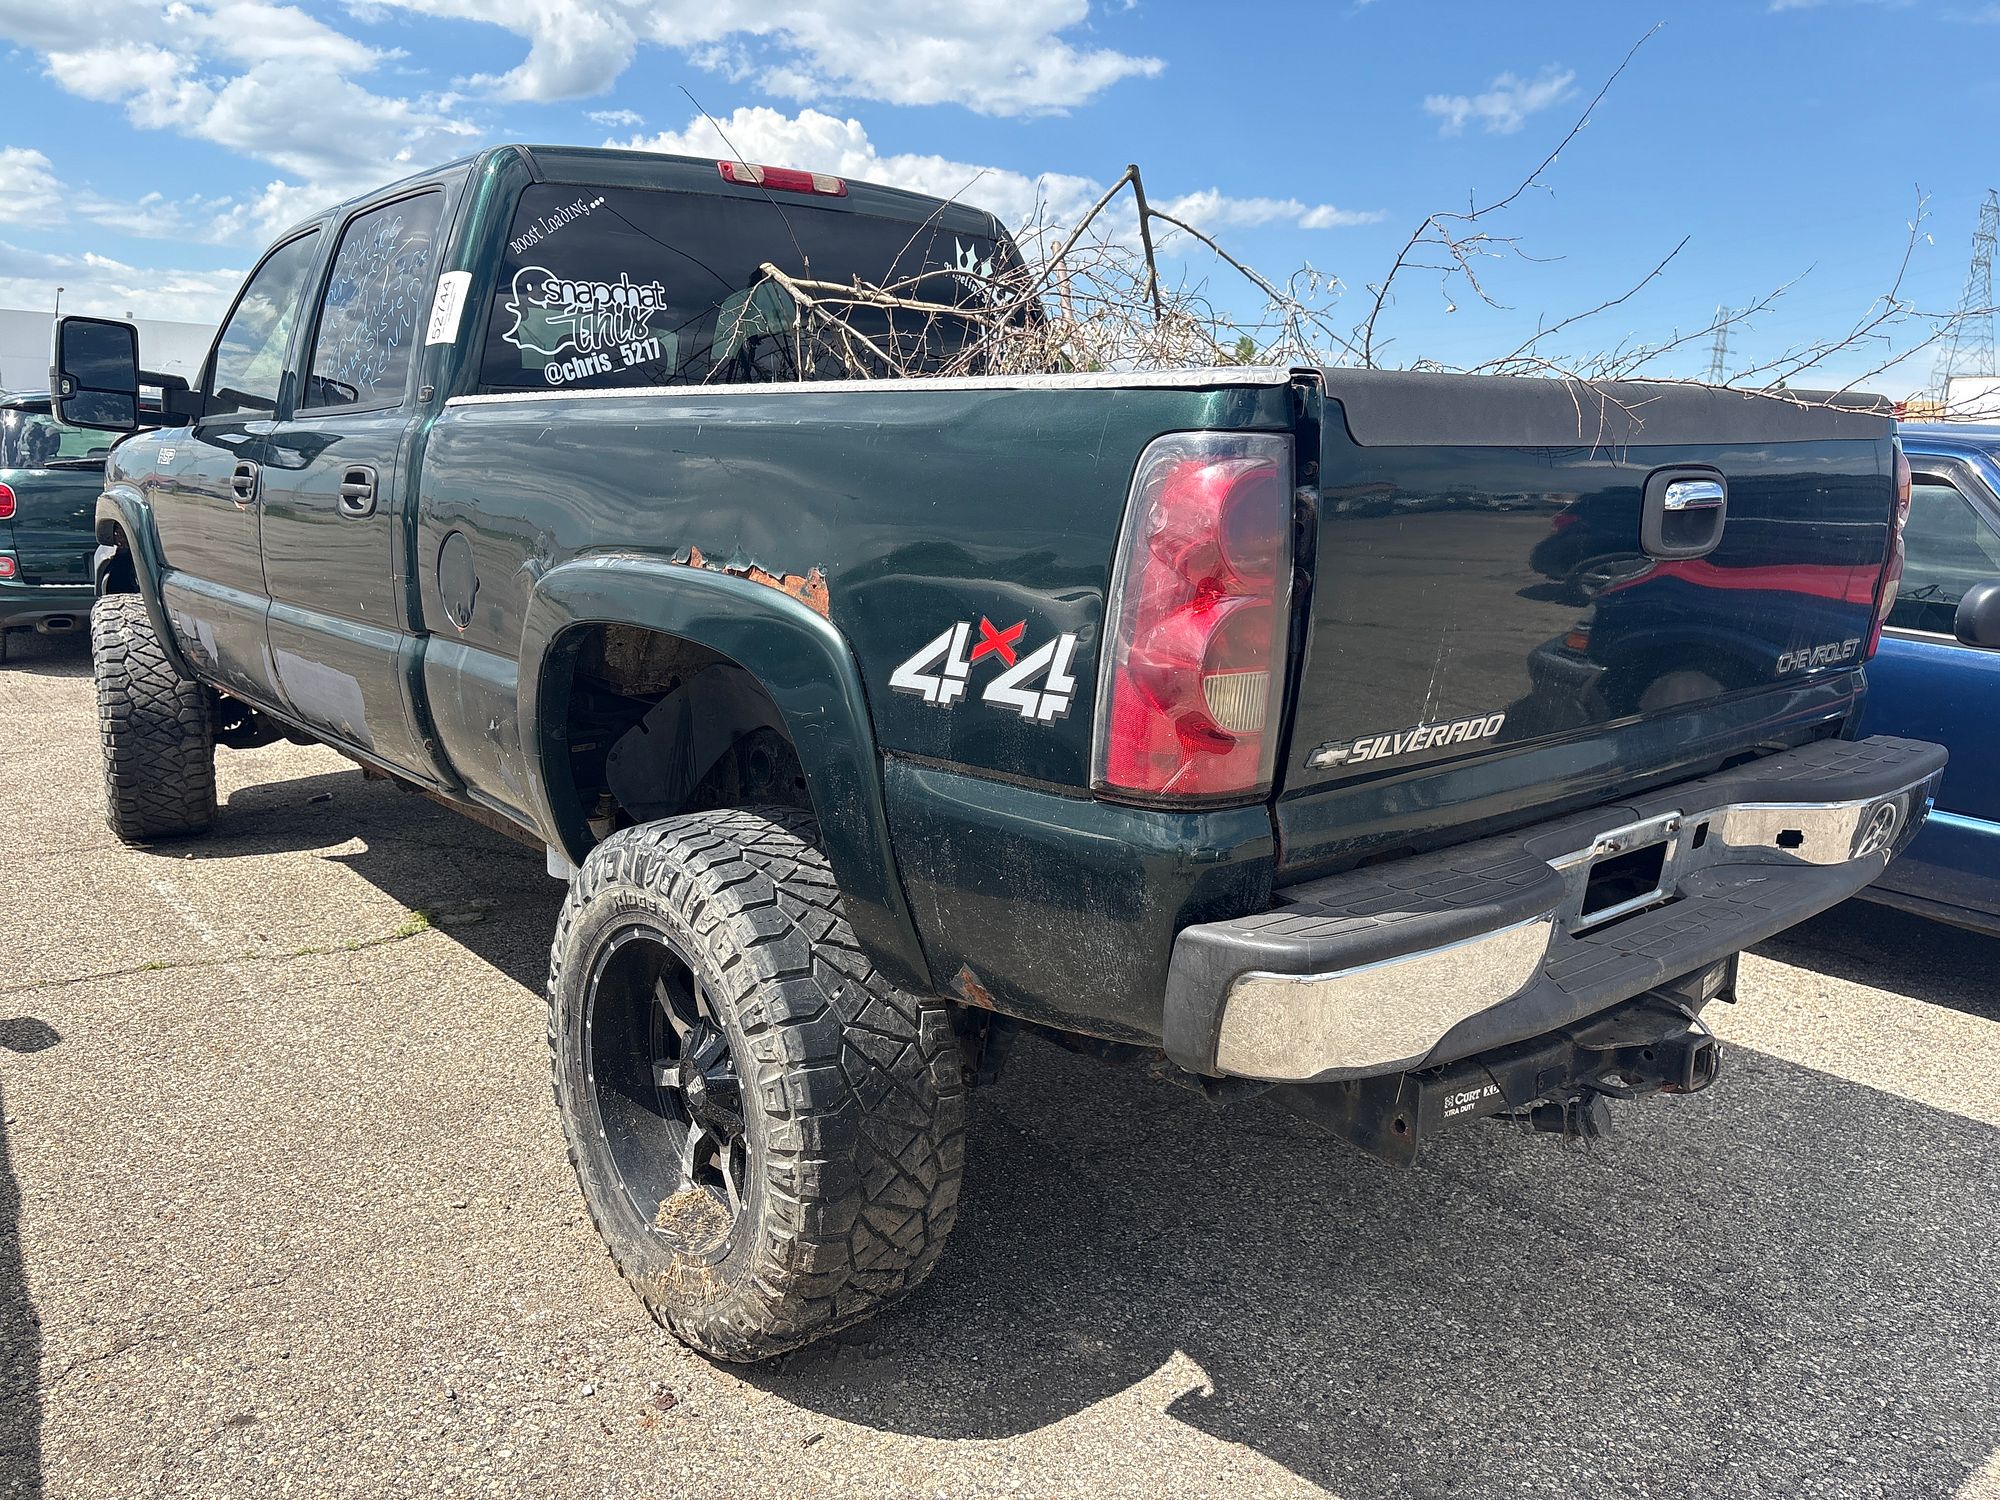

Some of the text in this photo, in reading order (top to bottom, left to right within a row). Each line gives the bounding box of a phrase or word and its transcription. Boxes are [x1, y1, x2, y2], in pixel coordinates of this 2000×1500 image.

[541, 271, 667, 310] snapchat
[546, 300, 655, 353] this
[543, 337, 661, 385] @chris_5217
[1775, 638, 1861, 675] CHEVROLET
[1346, 710, 1506, 765] SILVERADO
[1443, 1103, 1475, 1118] XTRA DUTY
[1455, 1089, 1481, 1105] CURT
